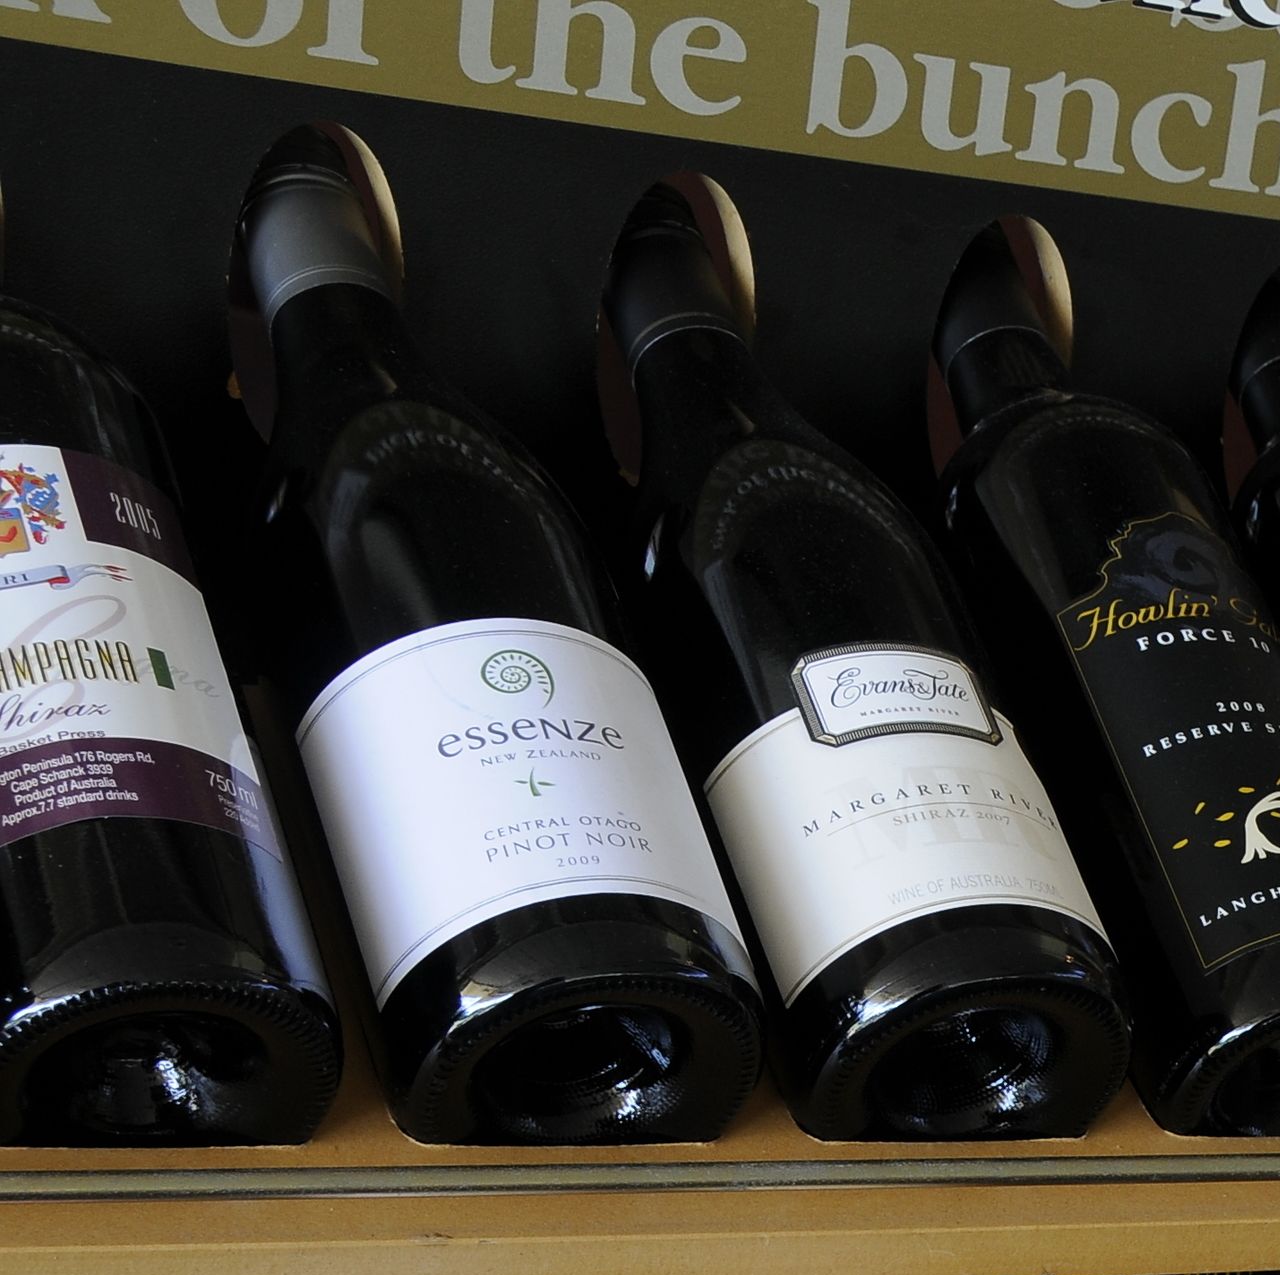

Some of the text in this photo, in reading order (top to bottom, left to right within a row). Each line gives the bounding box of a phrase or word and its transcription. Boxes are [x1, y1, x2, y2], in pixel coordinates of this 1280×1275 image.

[110, 492, 161, 540] 2005
[1074, 587, 1218, 651] Howlin'
[1137, 628, 1271, 653] FORCE 10
[1216, 701, 1266, 713] 2008
[1142, 720, 1253, 758] RESERVE
[22, 753, 74, 779] Peninsula
[803, 783, 971, 838] MARGARET
[483, 815, 642, 842] CENTRAL OTAGO
[485, 832, 652, 863] PINOT NOIR
[557, 855, 601, 868] 2009
